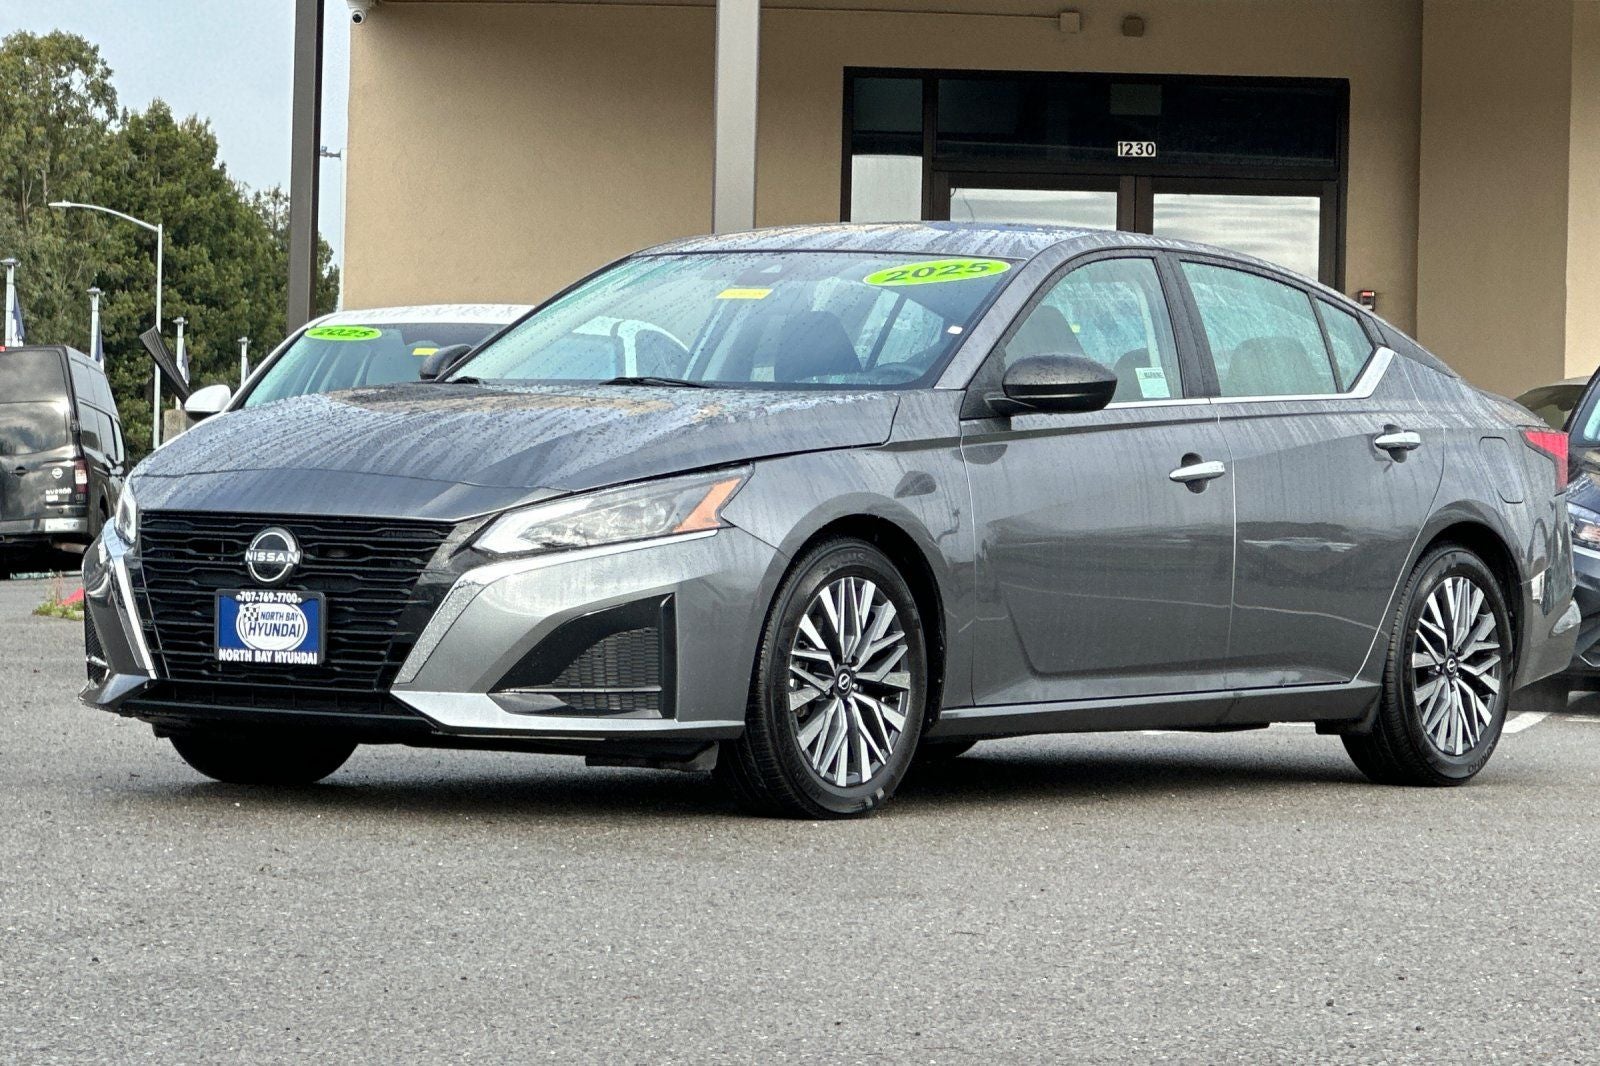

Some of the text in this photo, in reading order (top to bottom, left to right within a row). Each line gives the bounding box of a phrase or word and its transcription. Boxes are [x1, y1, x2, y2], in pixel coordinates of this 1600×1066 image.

[1119, 142, 1155, 156] 1230
[884, 262, 991, 282] 2025
[244, 550, 301, 564] NISSAN
[239, 591, 298, 603] 707-769-7700
[260, 611, 299, 622] NORTH BAY
[248, 622, 301, 638] HYUNDAI
[218, 649, 318, 664] NORTH BAY HYUNDAI
